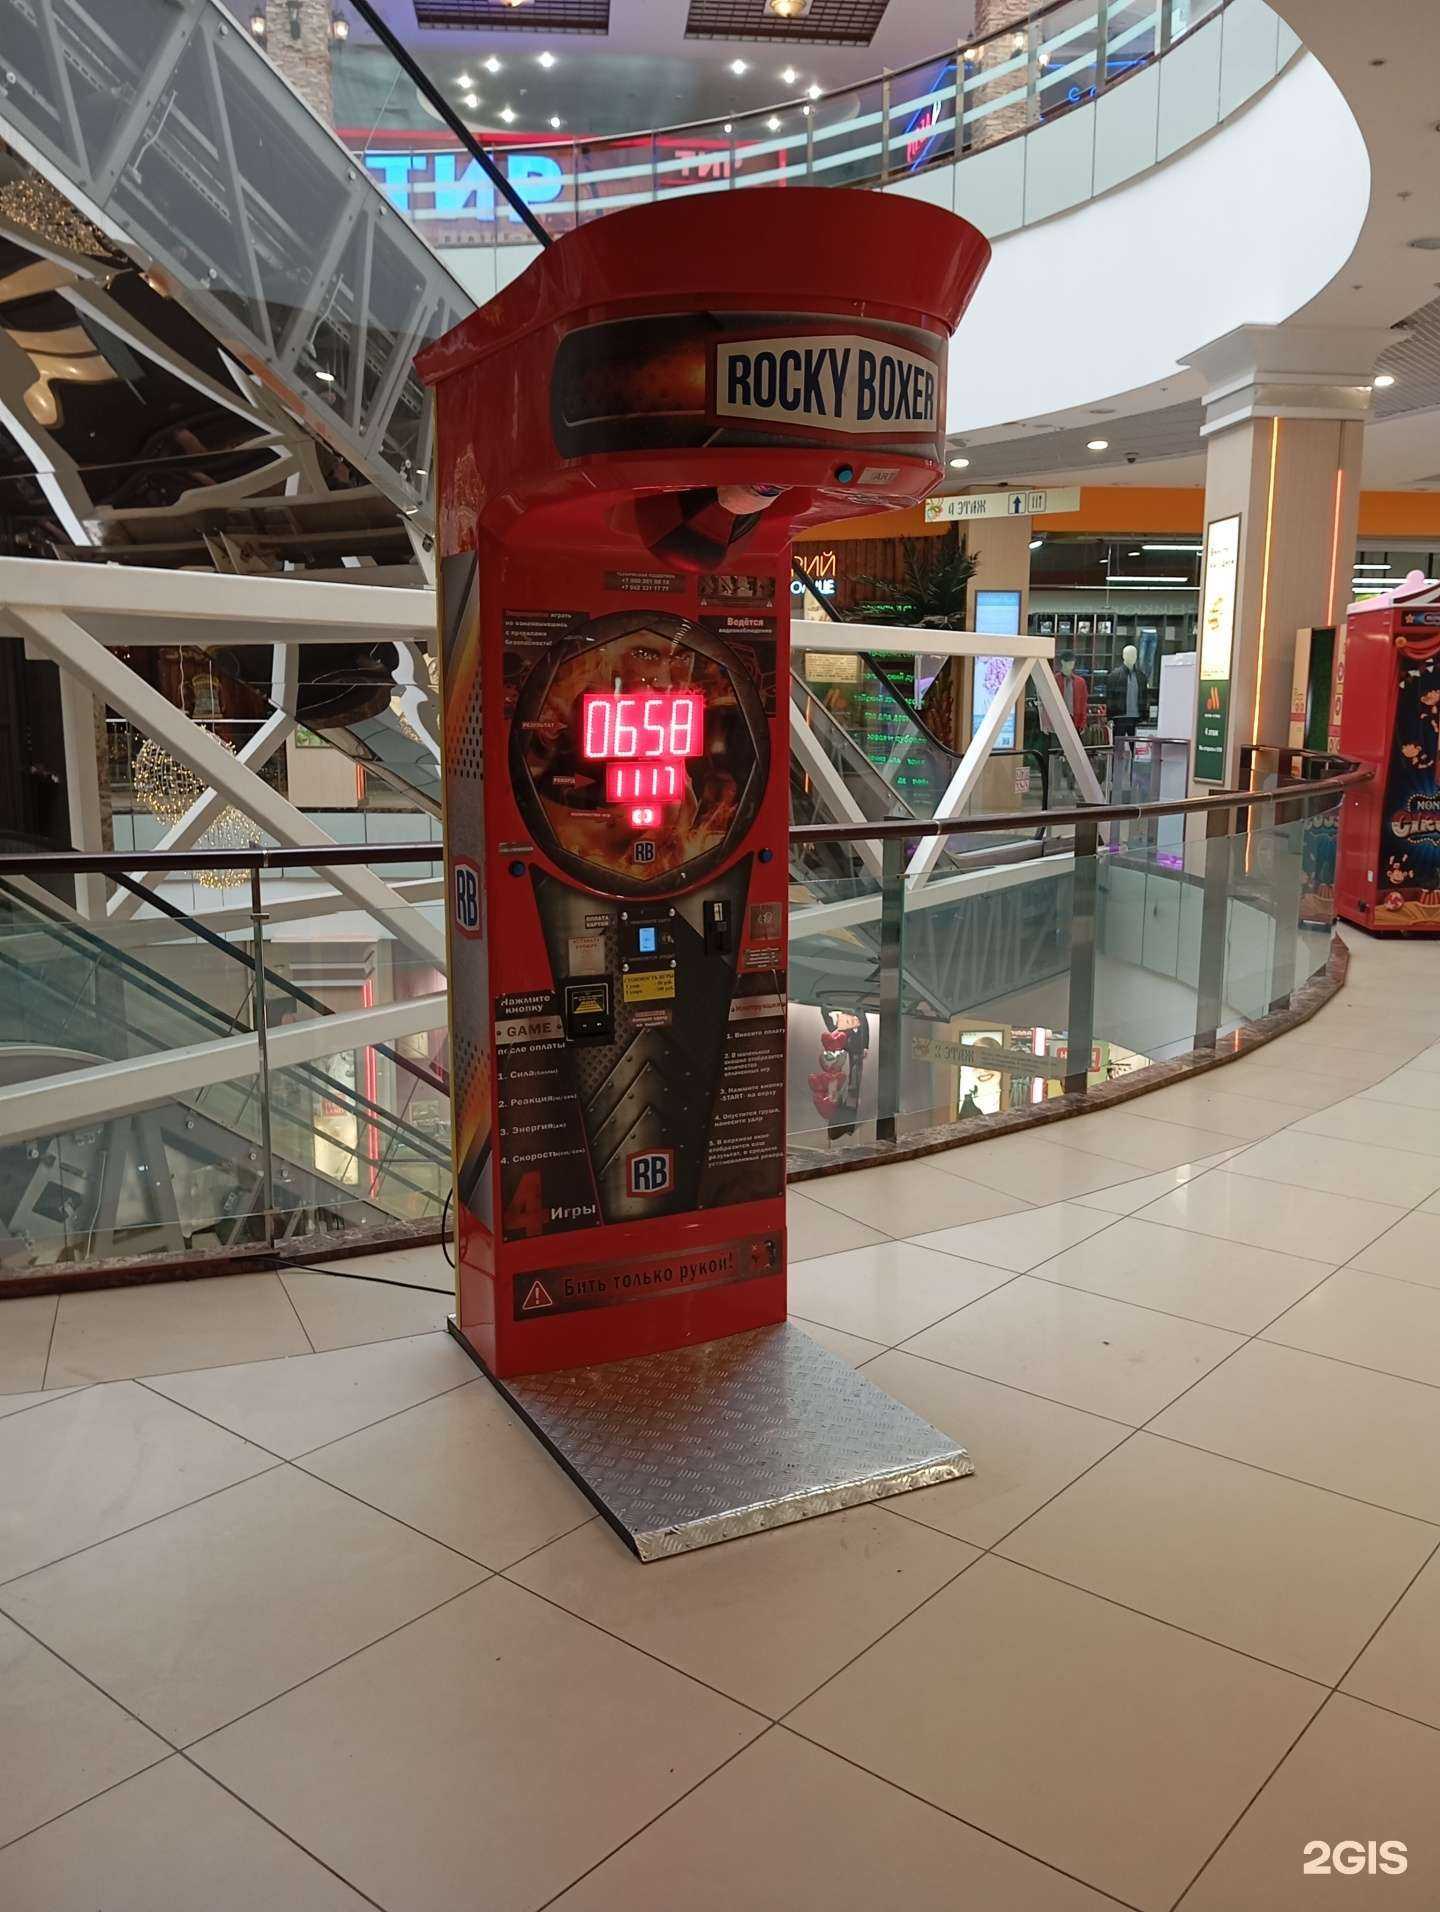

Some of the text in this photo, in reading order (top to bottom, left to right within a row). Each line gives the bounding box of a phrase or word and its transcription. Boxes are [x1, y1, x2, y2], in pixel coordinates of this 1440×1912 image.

[674, 149, 744, 178] ТИР
[365, 153, 564, 223] ТИР
[728, 347, 934, 420] ROCKY BOXER
[958, 499, 986, 514] ЭТАЖ
[726, 616, 764, 628] Ведётся
[585, 699, 693, 758] 0658
[616, 766, 675, 798] 1117
[635, 843, 654, 861] RB
[456, 869, 478, 927] RB
[505, 1004, 543, 1014] кнопку
[507, 1022, 552, 1037] GAME
[529, 1042, 566, 1052] оплаты
[633, 1155, 667, 1191] RB
[550, 1204, 596, 1220] Игры
[564, 1278, 607, 1297] Бить
[613, 1265, 673, 1289] только
